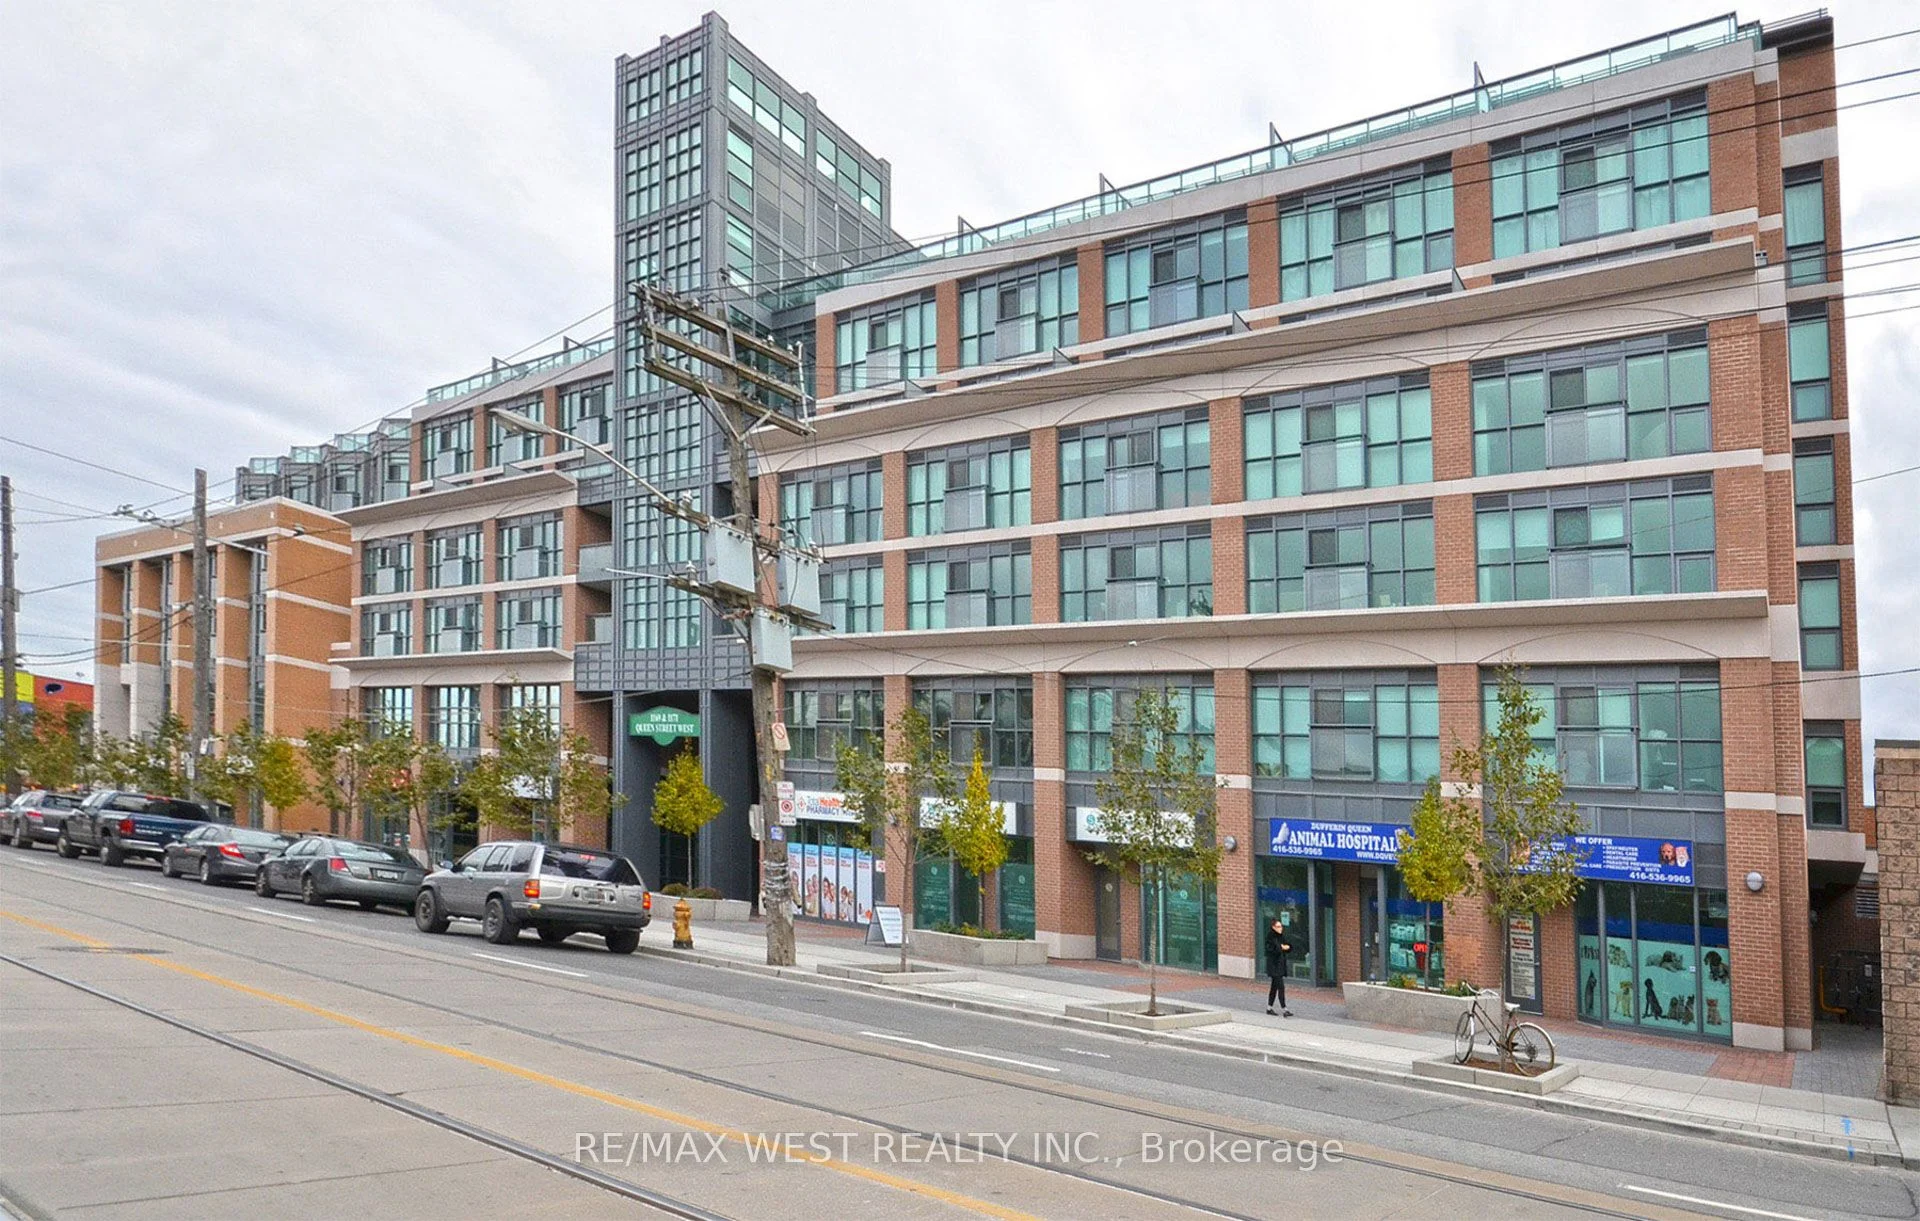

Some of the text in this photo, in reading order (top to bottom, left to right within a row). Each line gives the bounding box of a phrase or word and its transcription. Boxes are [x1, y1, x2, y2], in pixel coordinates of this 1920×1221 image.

[635, 723, 695, 734] QUEEN STREET WEST
[806, 805, 840, 816] PHARMACY
[1311, 822, 1372, 833] DUFFERIN QUEEN
[1289, 830, 1397, 852] ANIMAL HOSPITAL
[1588, 837, 1613, 845] OFFER
[1629, 871, 1691, 884] 416-536-9965
